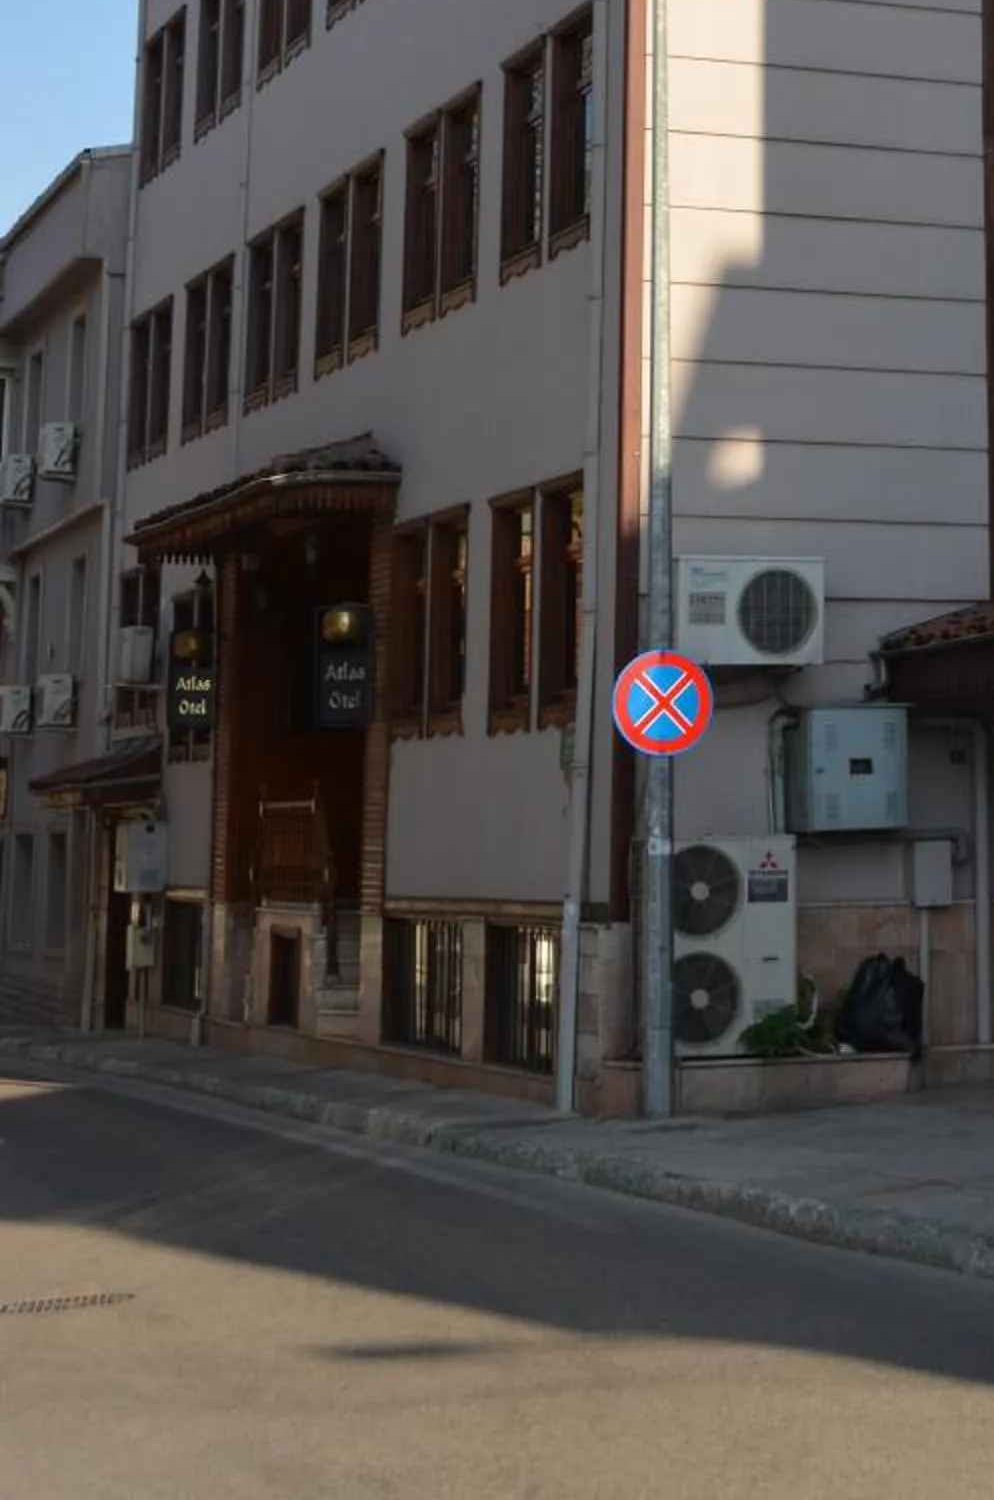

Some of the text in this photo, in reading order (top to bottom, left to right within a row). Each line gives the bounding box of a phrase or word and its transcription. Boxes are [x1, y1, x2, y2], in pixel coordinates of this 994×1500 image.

[324, 661, 366, 681] Atlas
[176, 675, 212, 692] Atlas
[178, 699, 206, 716] Otel
[329, 691, 361, 709] Otel
